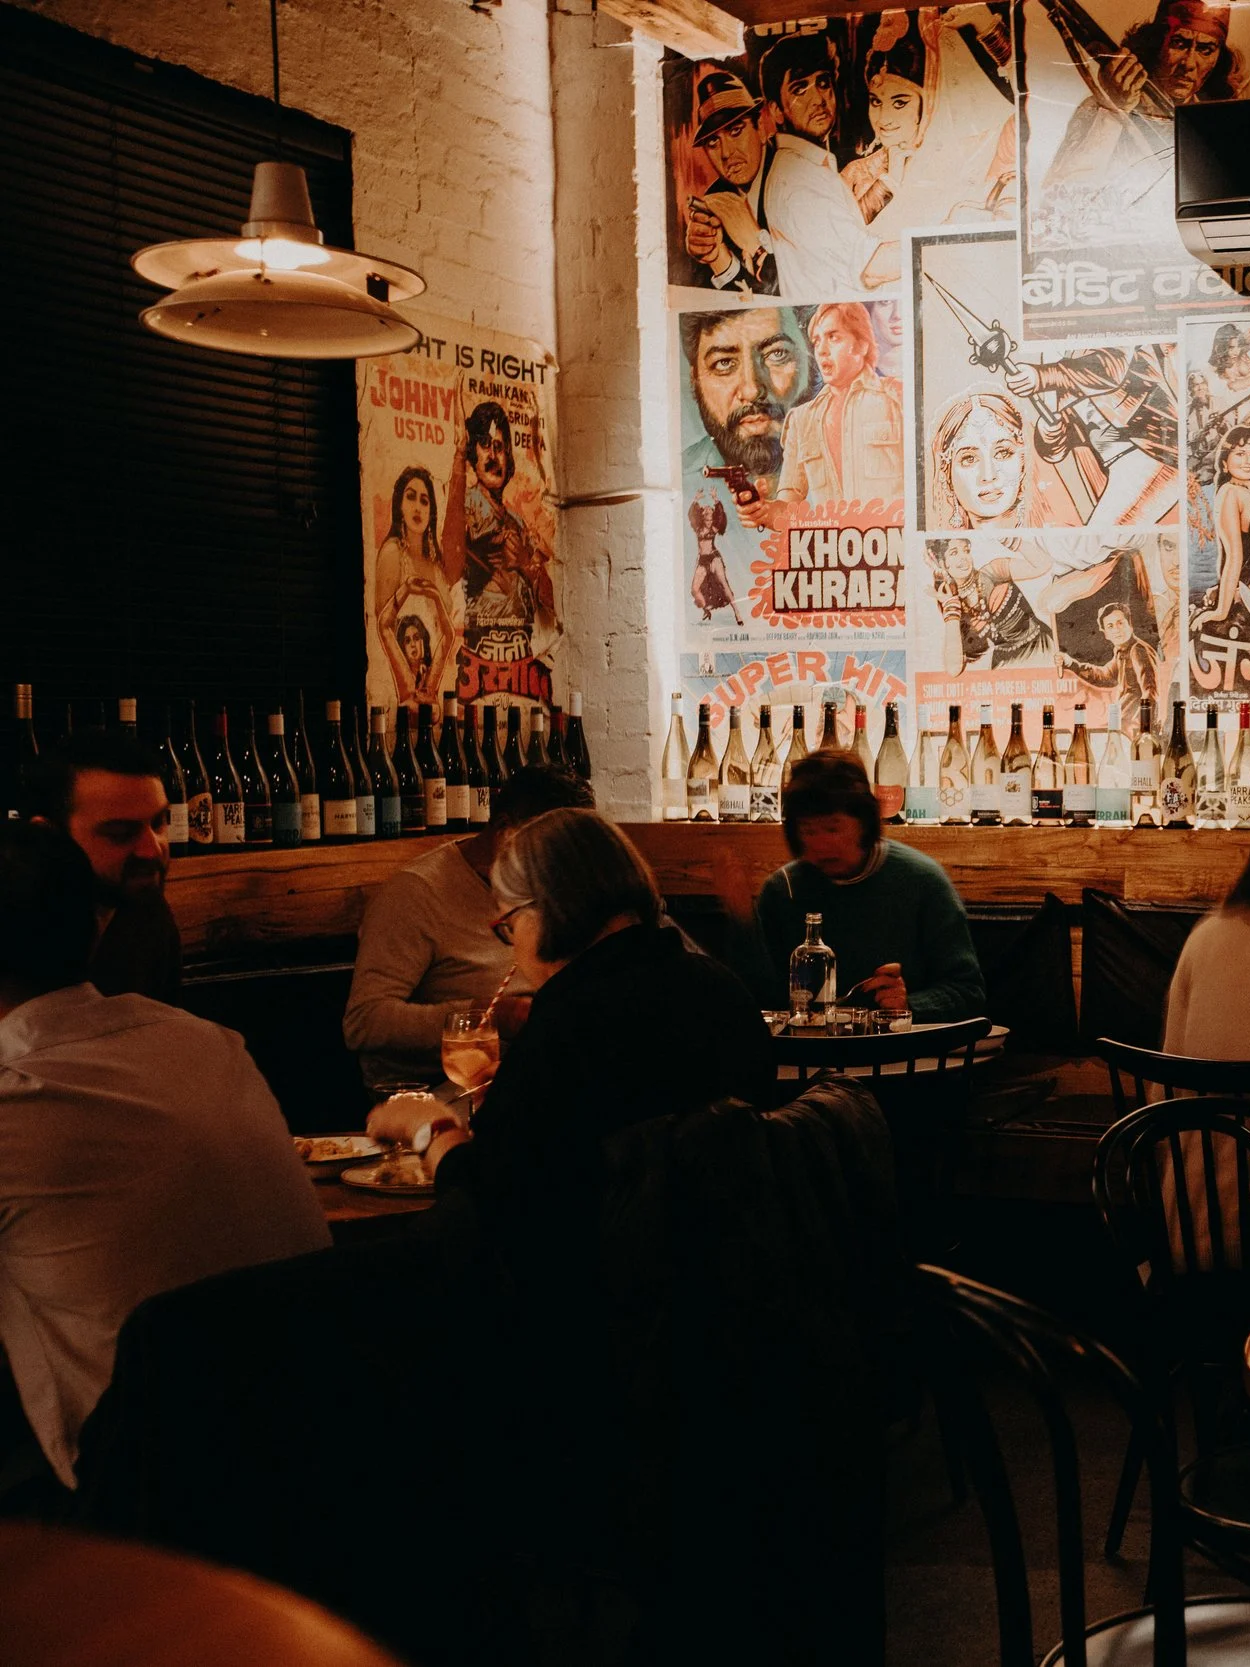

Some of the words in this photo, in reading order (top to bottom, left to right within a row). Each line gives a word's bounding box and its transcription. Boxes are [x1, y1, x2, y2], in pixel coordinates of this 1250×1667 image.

[455, 344, 474, 369] IS
[481, 349, 548, 385] RIGHT
[370, 366, 455, 422] JOHNY
[393, 415, 446, 446] USTAD
[514, 431, 547, 451] DEEA
[479, 631, 527, 663] जॉनी
[698, 651, 828, 730] SUPER
[841, 655, 908, 708] HIT
